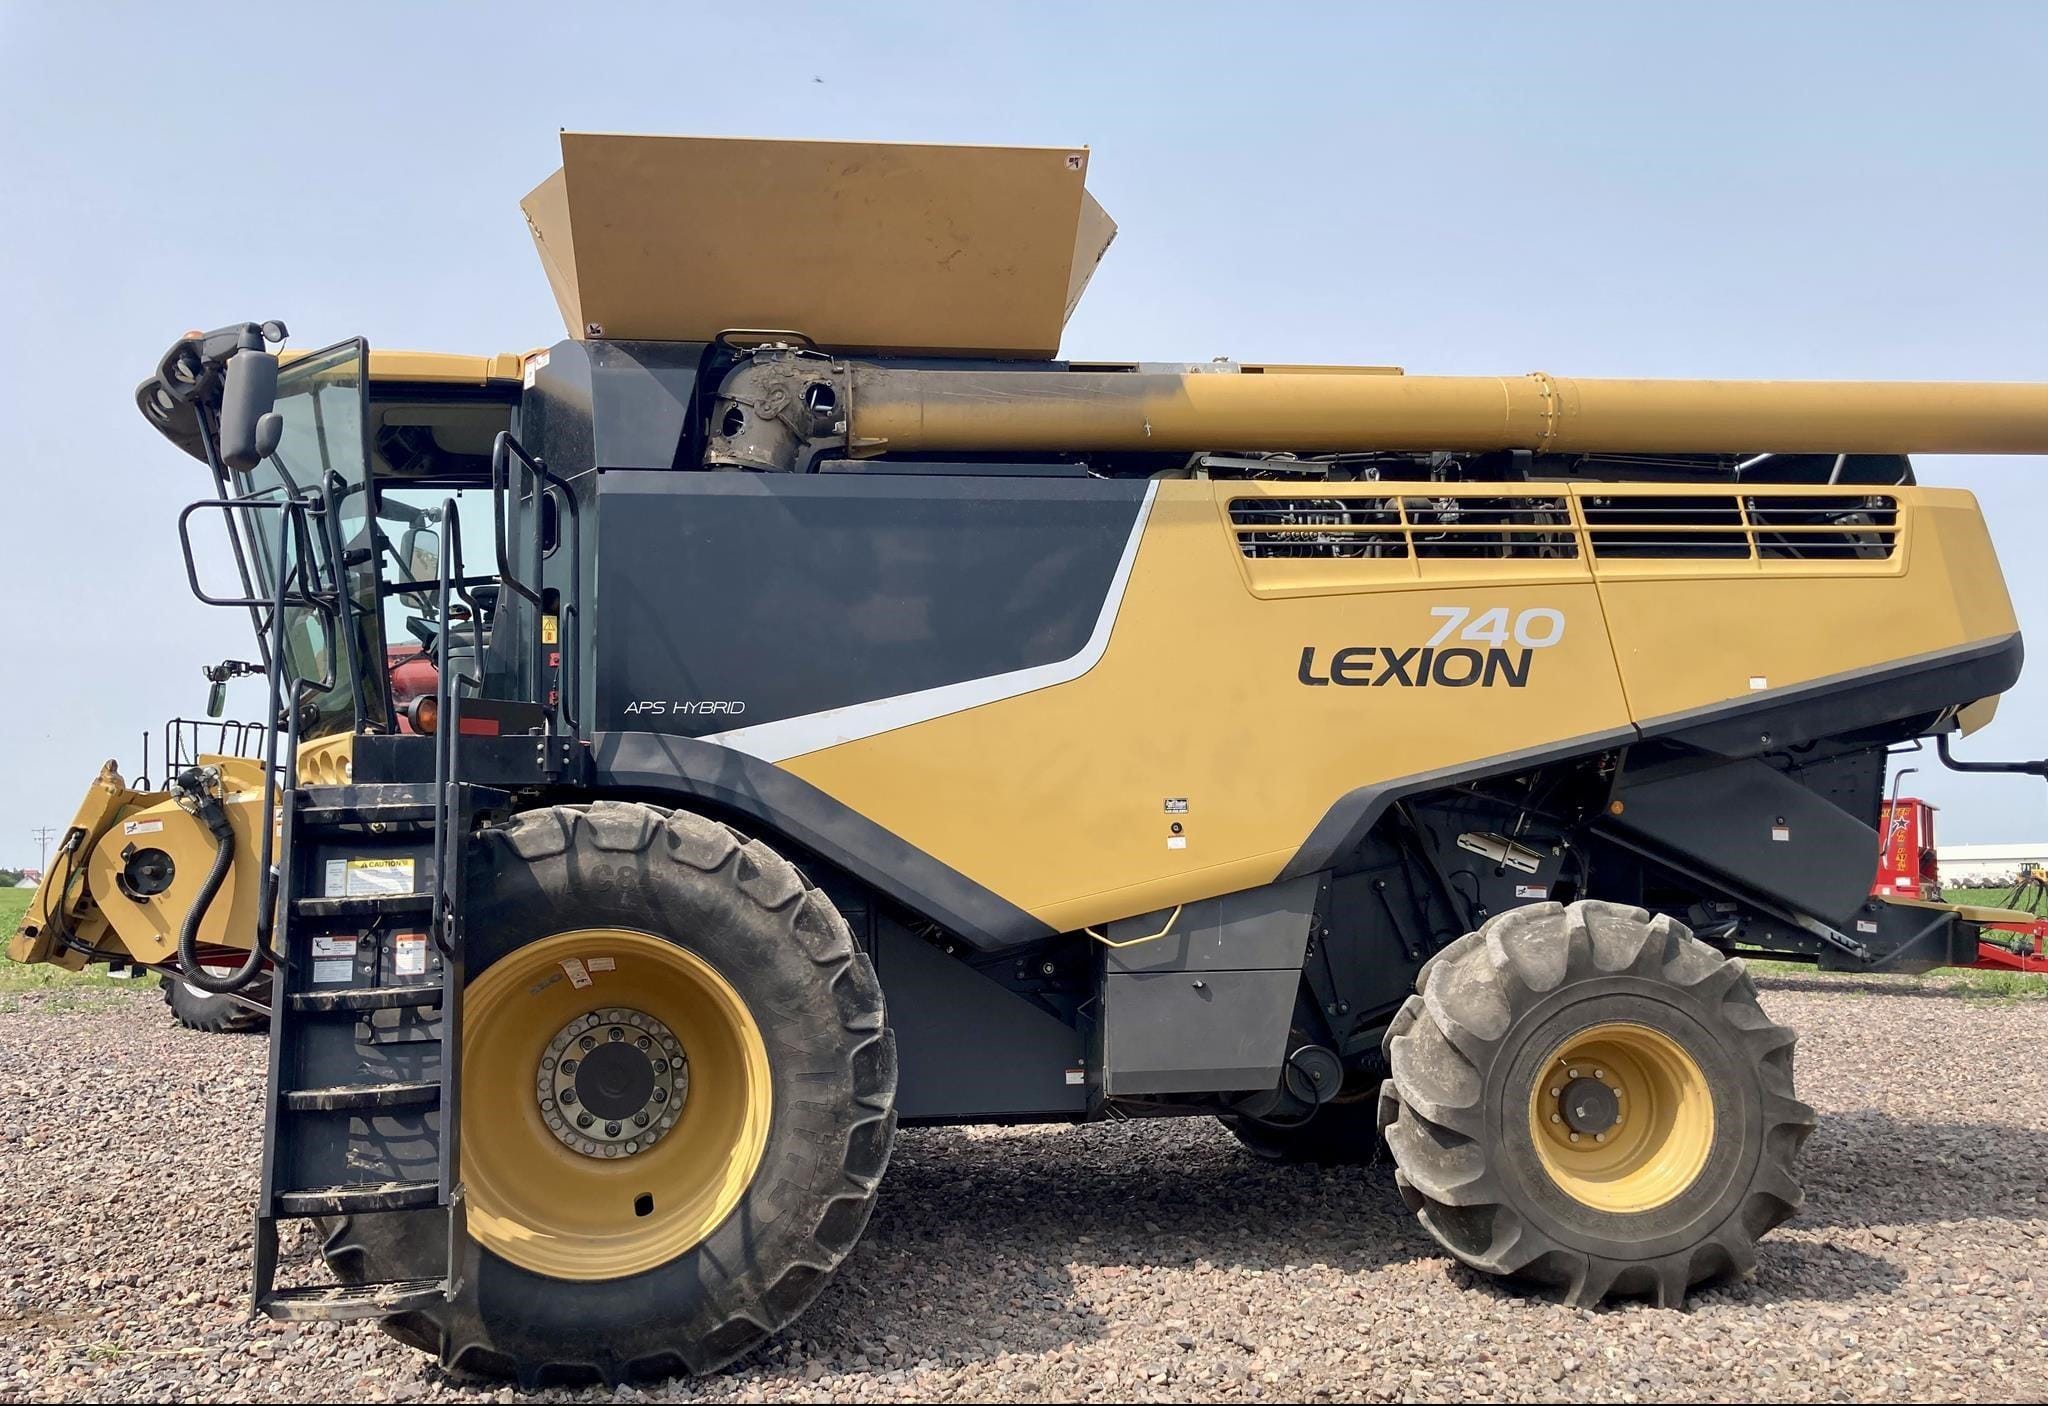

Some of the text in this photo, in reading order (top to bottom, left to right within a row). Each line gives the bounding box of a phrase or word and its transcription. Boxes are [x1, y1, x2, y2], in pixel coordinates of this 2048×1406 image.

[1425, 606, 1565, 648] 740
[1297, 646, 1533, 687] LEXION
[624, 701, 746, 714] APS HYBRID
